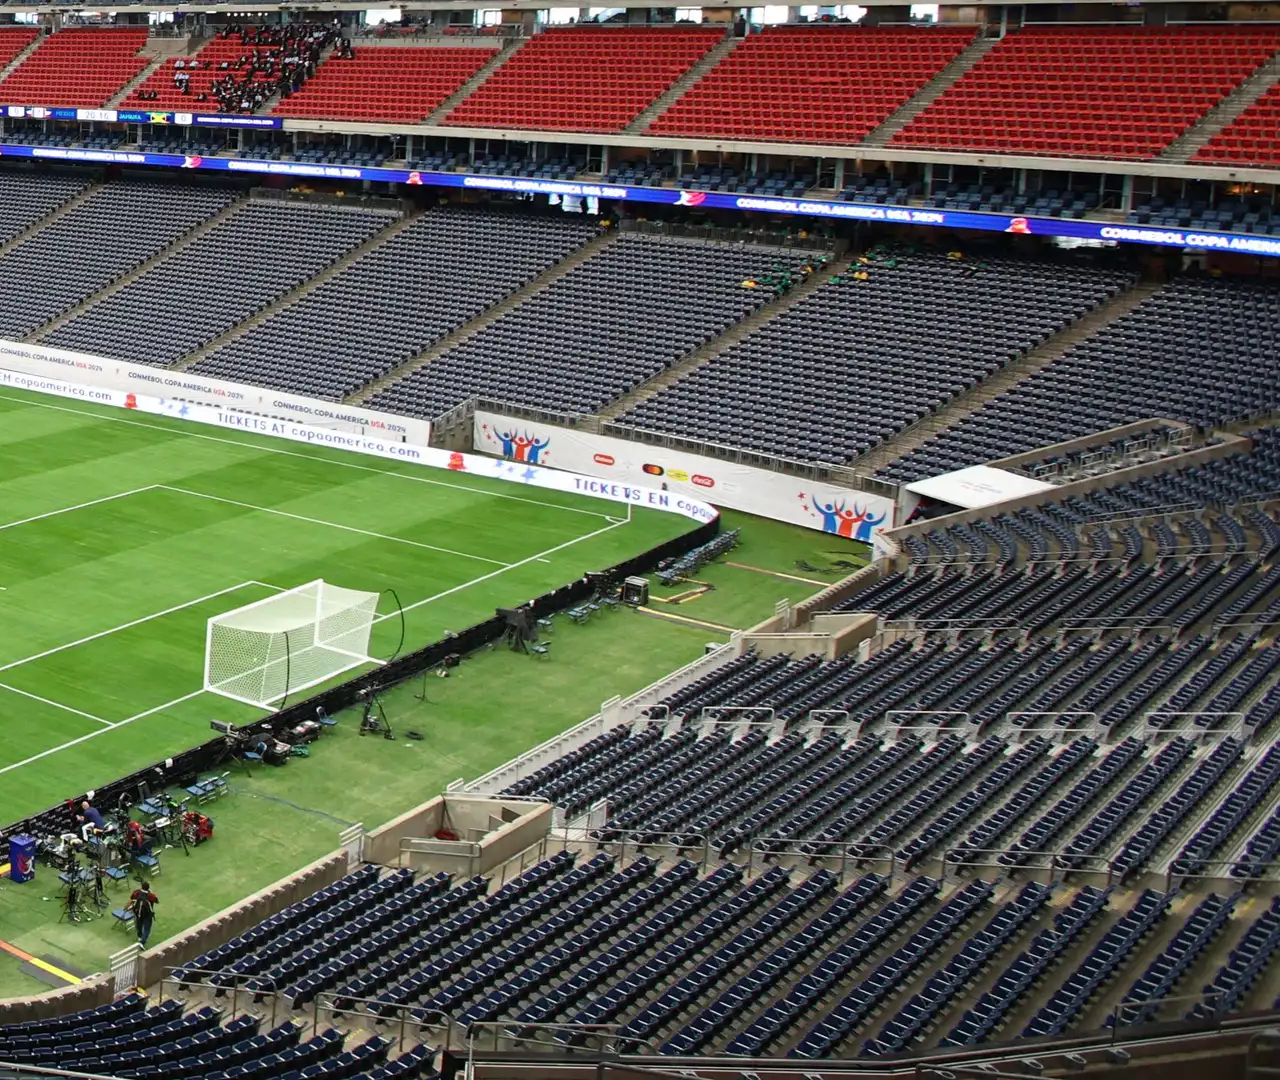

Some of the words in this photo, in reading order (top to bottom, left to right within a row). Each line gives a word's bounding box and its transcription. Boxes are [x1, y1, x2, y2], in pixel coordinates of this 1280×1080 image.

[1100, 228, 1185, 244] CONMEBOL
[1185, 233, 1229, 247] COPA
[128, 371, 164, 385] CONMEBOL
[164, 378, 183, 388] COPA
[183, 382, 212, 394] AMERICA
[213, 388, 226, 397] USA
[227, 390, 244, 400] 2024
[217, 413, 267, 430] TICKETS
[272, 423, 286, 434] AT
[273, 400, 313, 414] CONMEBOL
[314, 408, 334, 418] COPA
[334, 412, 370, 426] AMERICA
[370, 419, 386, 429] USA
[387, 423, 407, 433] 2024
[574, 478, 641, 501] TICKETS
[648, 492, 669, 507] EN
